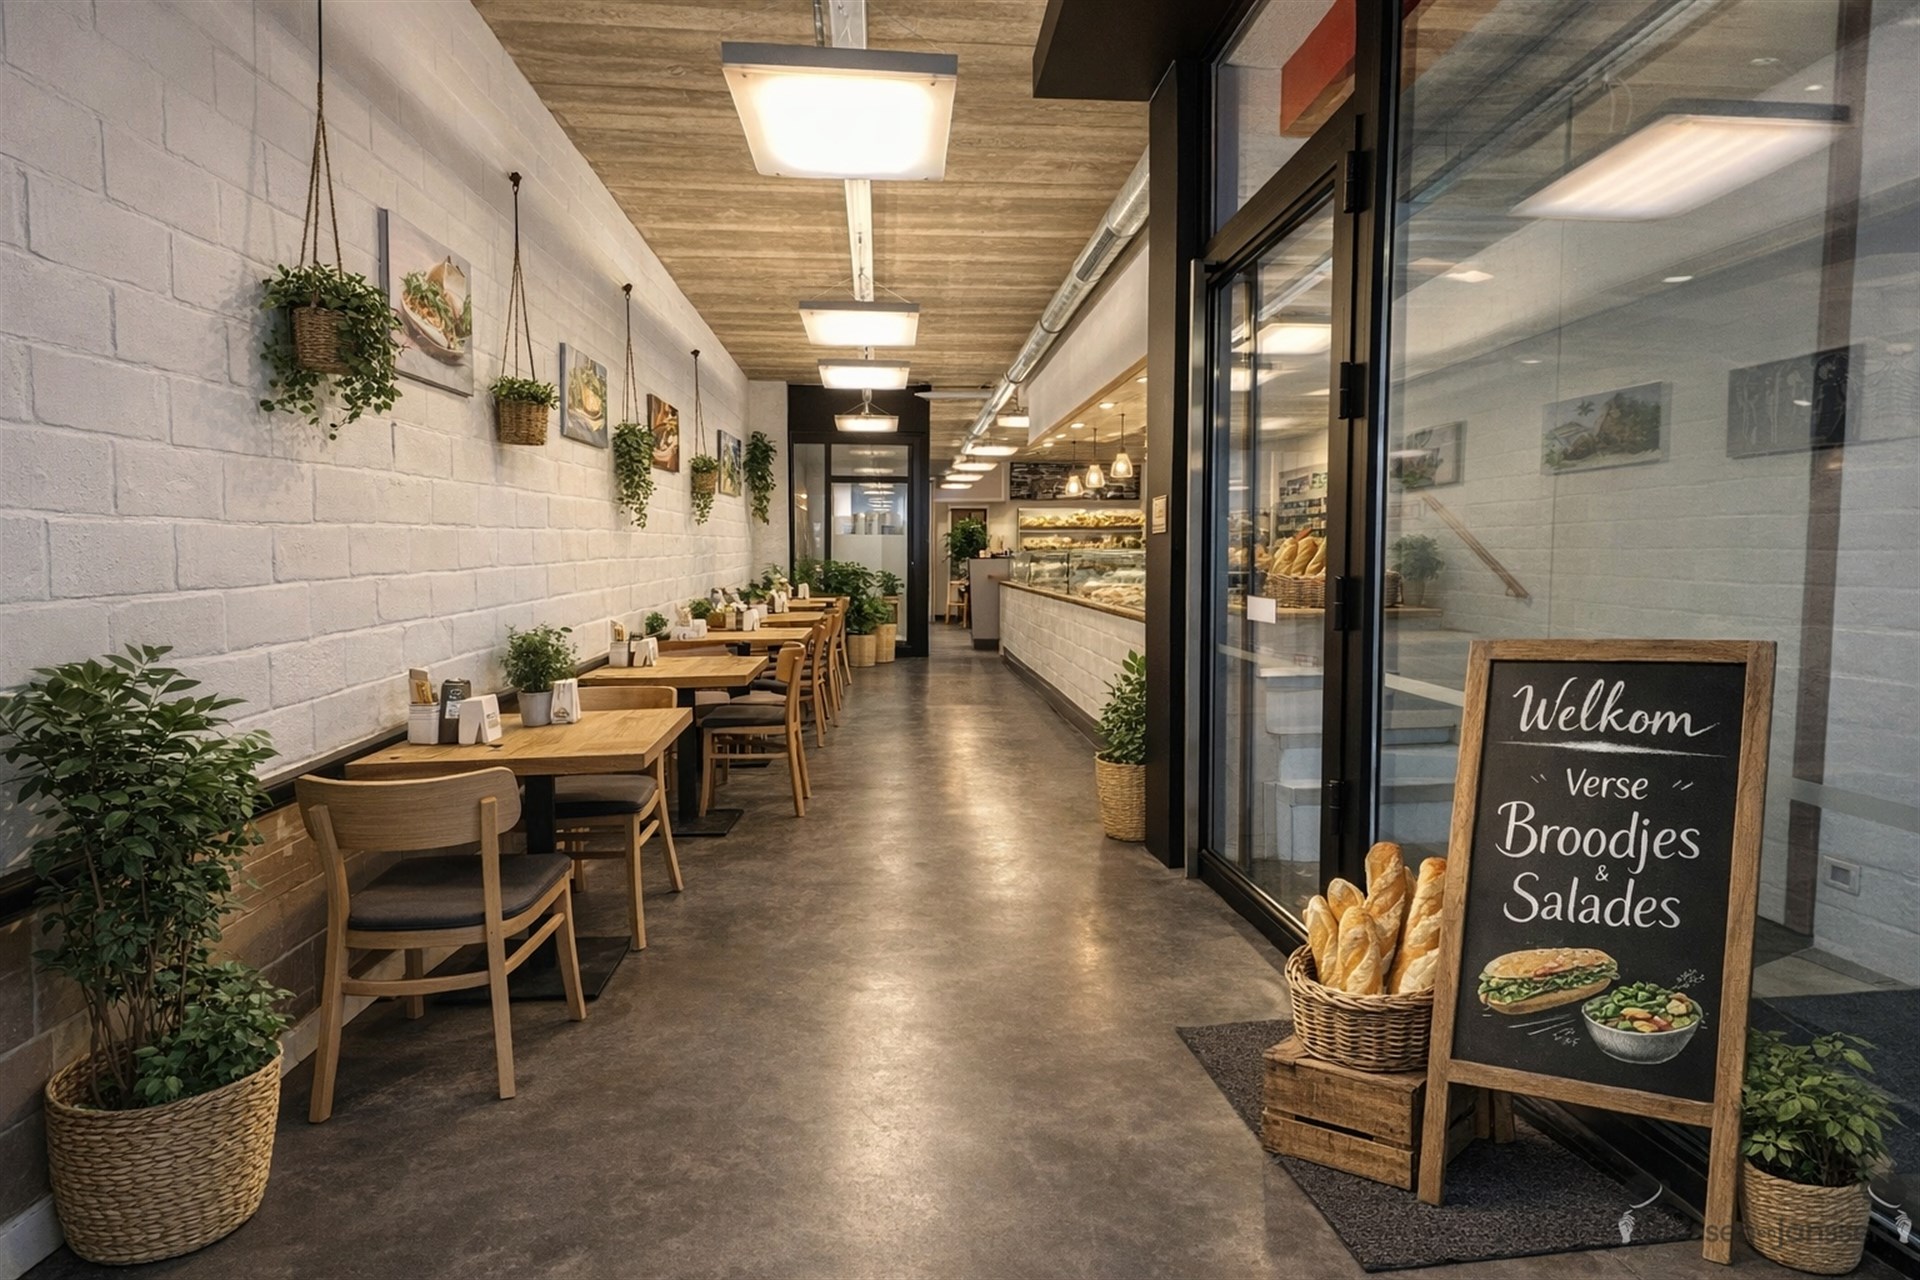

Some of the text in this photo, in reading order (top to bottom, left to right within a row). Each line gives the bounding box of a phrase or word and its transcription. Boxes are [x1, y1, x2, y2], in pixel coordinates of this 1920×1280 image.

[1512, 676, 1720, 738] Welkom
[1566, 767, 1649, 800] Verse
[1494, 800, 1700, 875] Broodjes
[1503, 871, 1681, 929] Salades
[1594, 864, 1609, 882] &
